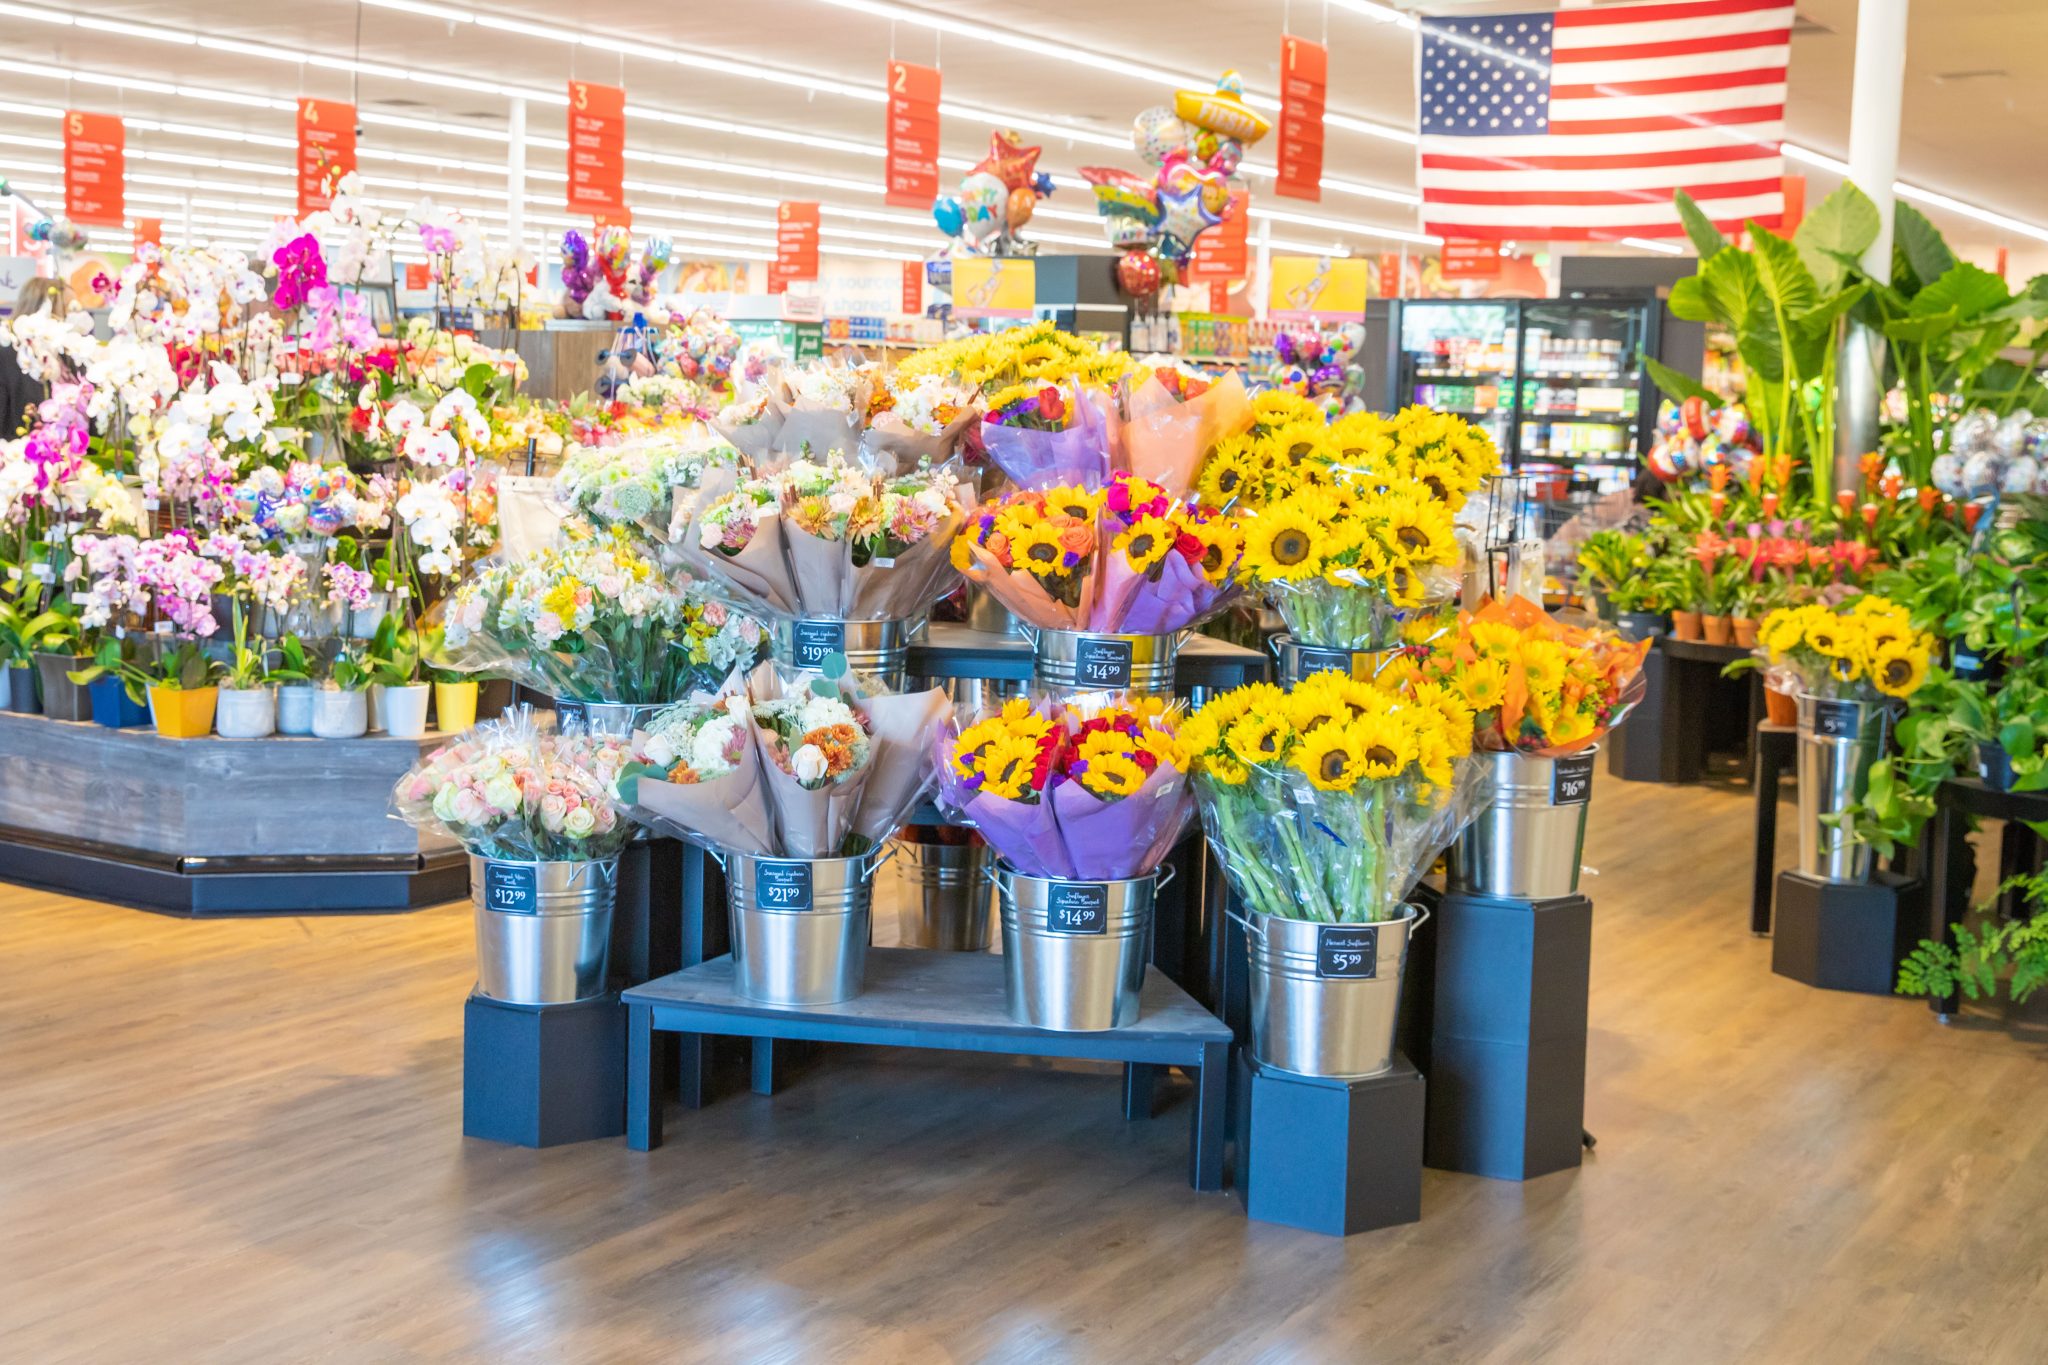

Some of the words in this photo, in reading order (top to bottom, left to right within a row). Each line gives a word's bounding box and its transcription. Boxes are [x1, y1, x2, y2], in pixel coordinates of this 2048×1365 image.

[893, 65, 907, 94] 2
[575, 84, 588, 111] 3
[69, 113, 84, 137] 5
[304, 101, 319, 125] 4
[1198, 102, 1255, 137] FIESTA
